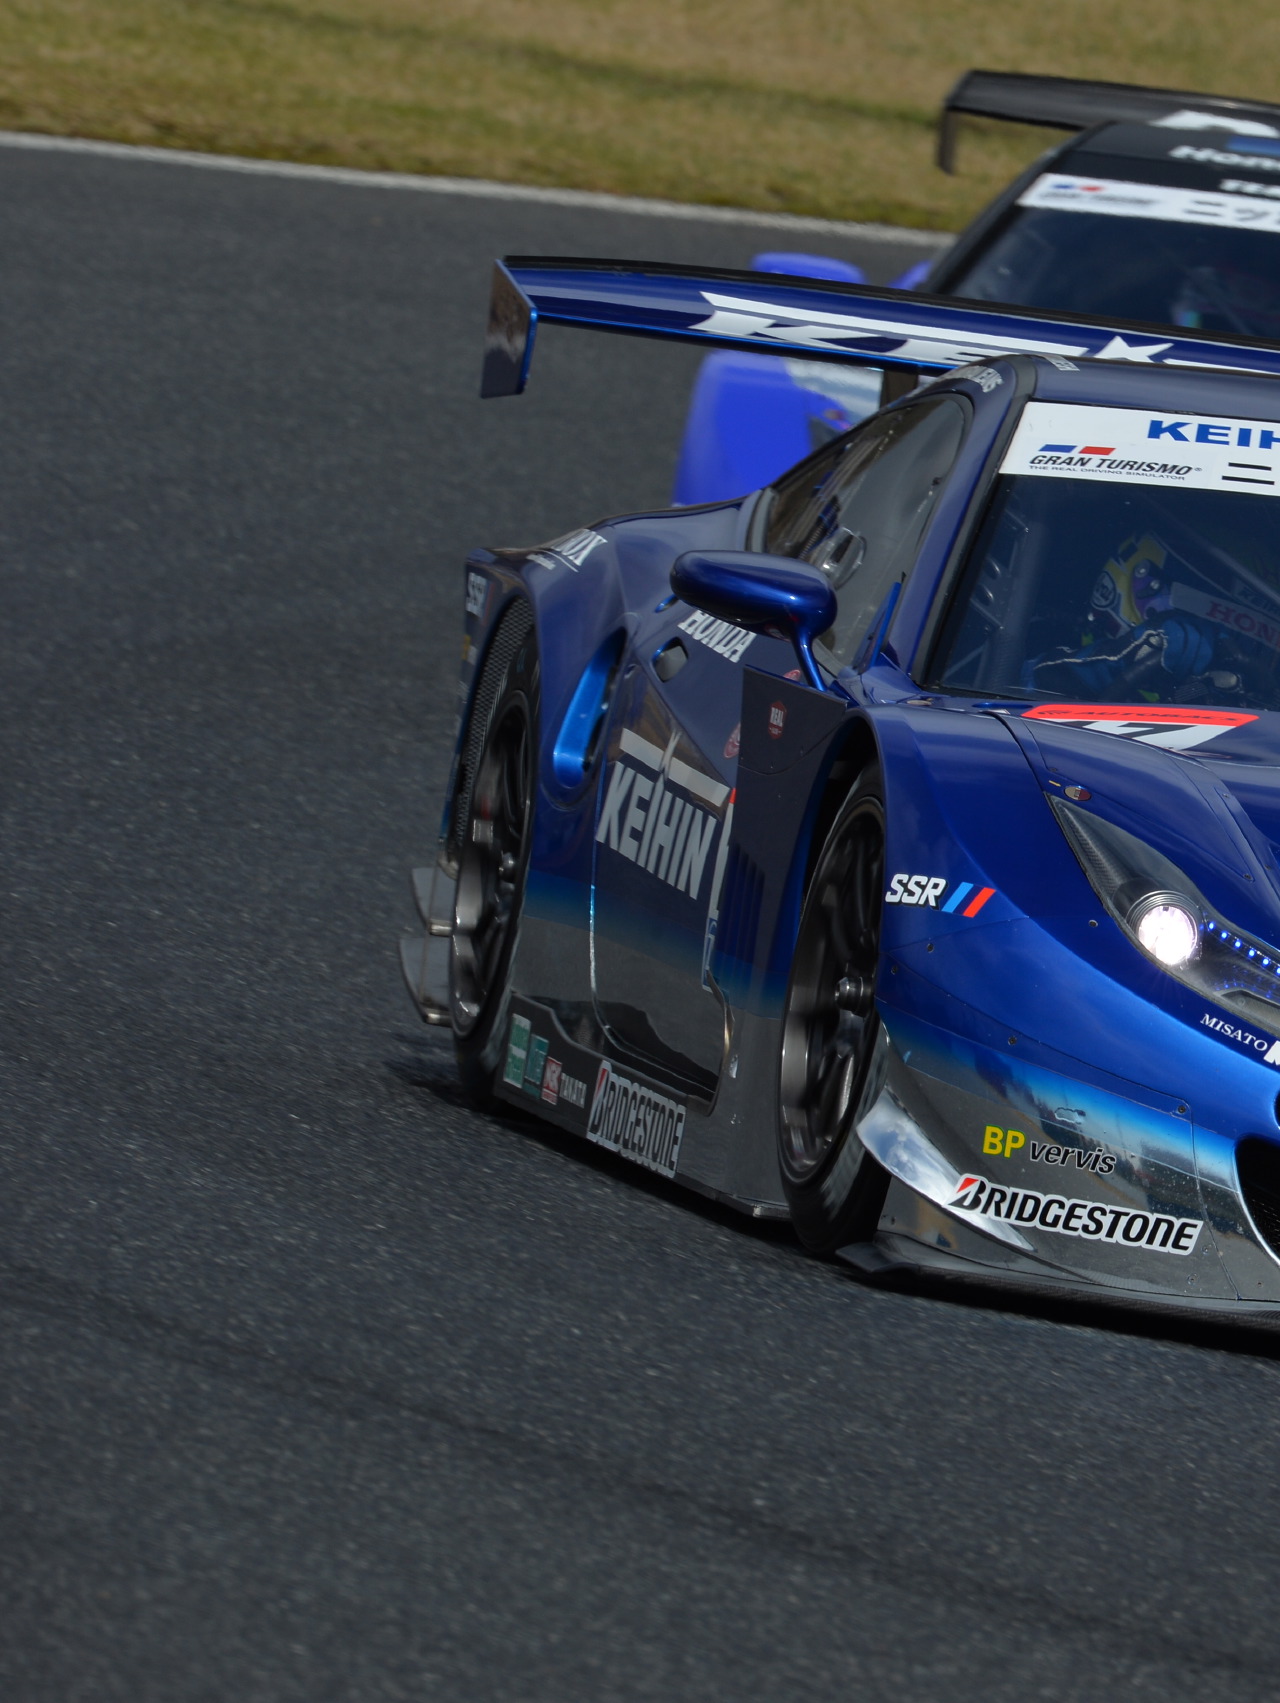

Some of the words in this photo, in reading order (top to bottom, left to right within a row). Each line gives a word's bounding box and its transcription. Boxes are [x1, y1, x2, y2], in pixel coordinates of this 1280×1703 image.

[1029, 455, 1092, 467] GRAN
[1125, 471, 1185, 481] SIMULATOR
[677, 610, 757, 664] HONDA
[596, 760, 718, 900] KEIHIN
[885, 874, 947, 908] SSR
[1200, 1013, 1268, 1052] MISATO
[588, 1066, 685, 1170] BRIDGESTONE
[983, 1125, 1026, 1158] BP
[1030, 1141, 1116, 1174] vervis
[950, 1177, 1198, 1251] BRIDGESTONE
